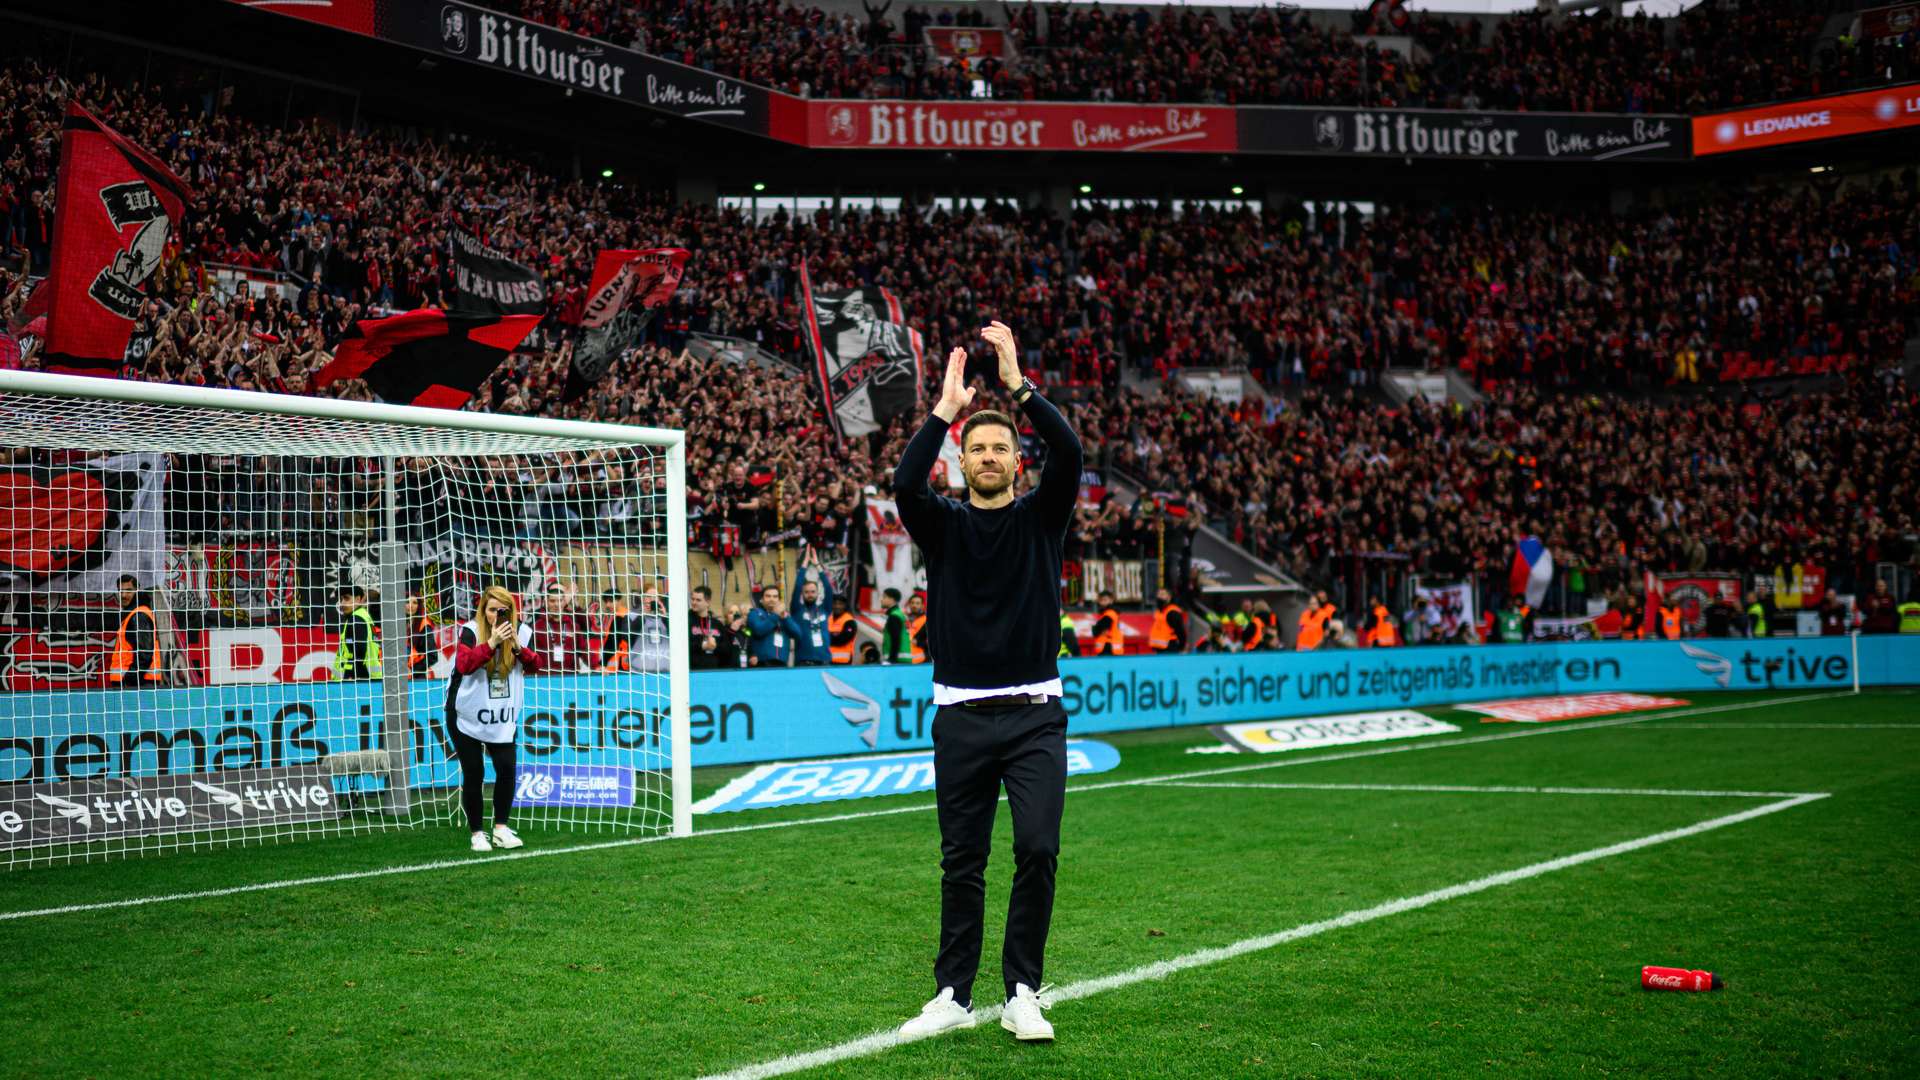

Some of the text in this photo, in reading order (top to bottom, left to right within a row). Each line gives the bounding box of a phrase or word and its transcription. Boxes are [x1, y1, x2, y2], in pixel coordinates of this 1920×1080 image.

[477, 14, 625, 95] Bitburger
[716, 80, 746, 106] Bit
[868, 104, 1044, 147] Bitburger
[1165, 109, 1208, 134] Bit
[1353, 113, 1519, 156] Bitburger
[1633, 118, 1671, 144] Bit
[1743, 111, 1831, 136] LEDVANCE
[1062, 654, 1621, 716] Schlau, sicher und zeitgemäß investieren
[1741, 648, 1849, 683] trive
[94, 780, 330, 824] trive trive
